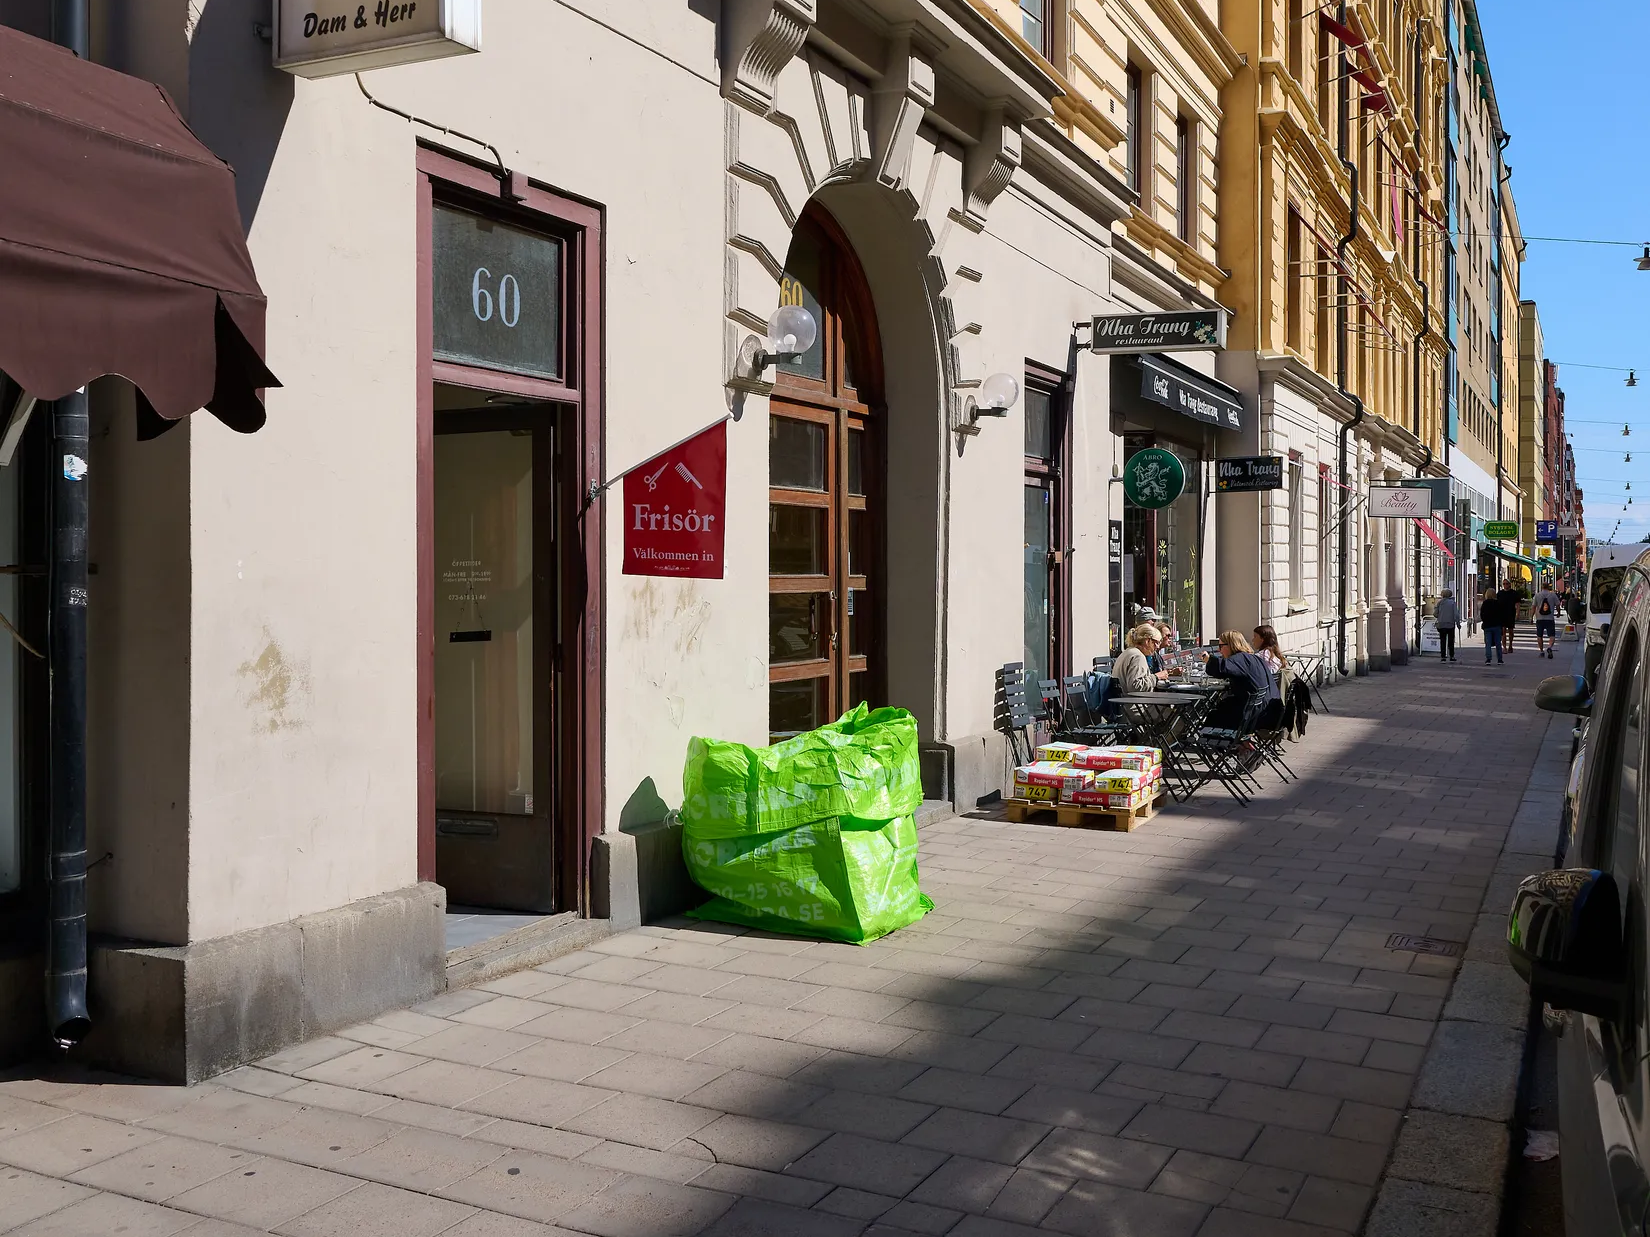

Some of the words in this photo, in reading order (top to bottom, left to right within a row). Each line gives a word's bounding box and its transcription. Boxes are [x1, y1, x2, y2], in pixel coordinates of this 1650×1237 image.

[304, 12, 346, 38] Dam
[353, 5, 367, 29] &
[374, 0, 416, 27] Herr
[472, 267, 520, 327] 60
[1097, 318, 1134, 337] Nha
[1140, 316, 1191, 337] Trang
[1115, 336, 1164, 345] restaurant
[1219, 462, 1243, 477] Nha
[1246, 461, 1280, 477] Trang
[1380, 496, 1418, 512] Beauty
[632, 503, 715, 532] Frisör
[1548, 524, 1555, 533] P
[632, 548, 699, 561] Välkommen
[702, 550, 715, 562] in
[1049, 750, 1068, 759] 747
[1111, 779, 1130, 789] 747
[1028, 787, 1047, 797] 747
